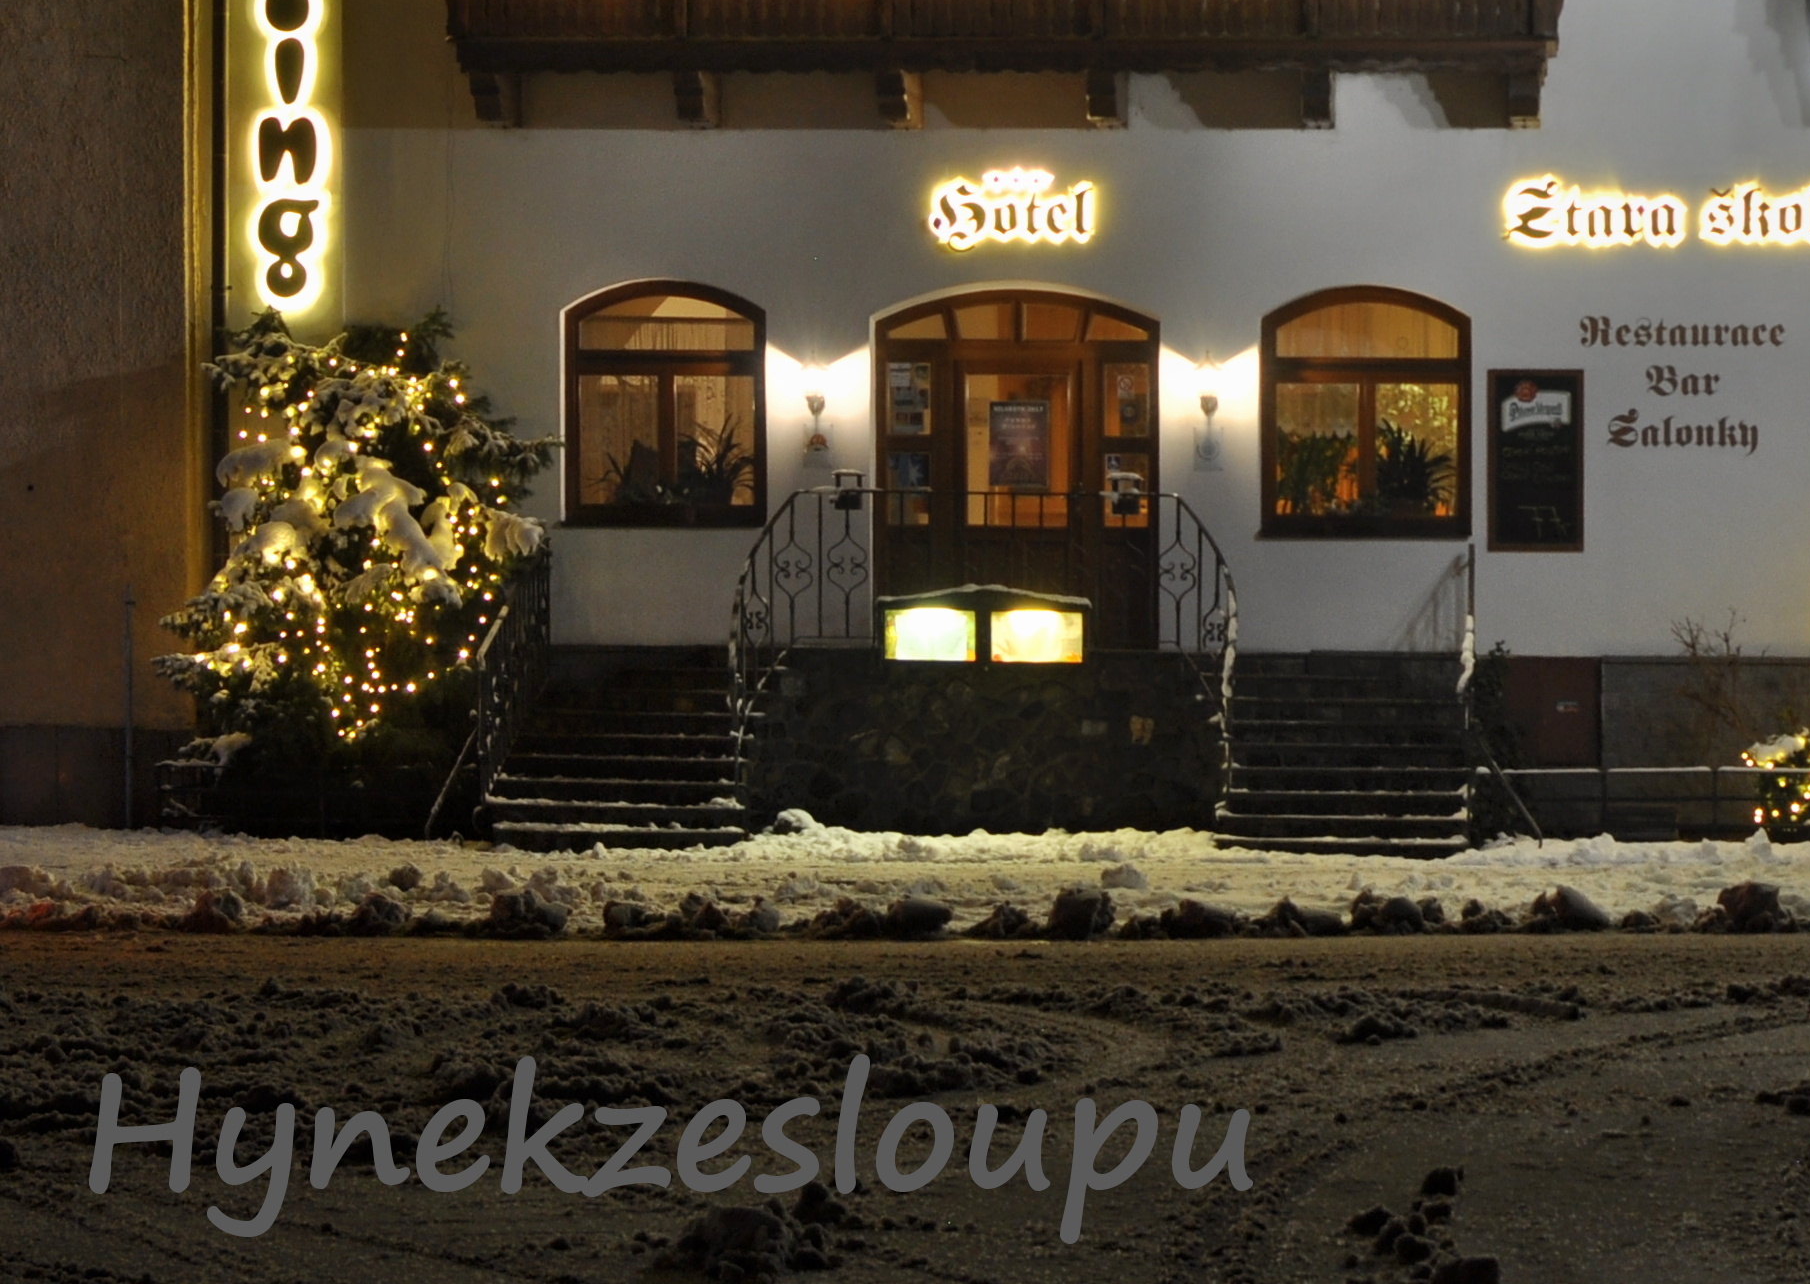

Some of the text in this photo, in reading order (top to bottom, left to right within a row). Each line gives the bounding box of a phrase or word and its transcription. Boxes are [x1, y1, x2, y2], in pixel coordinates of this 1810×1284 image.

[932, 182, 1095, 252] Hotel
[1579, 315, 1786, 347] Restaurace
[1645, 365, 1720, 397] Bar
[1607, 407, 1759, 457] Salonky
